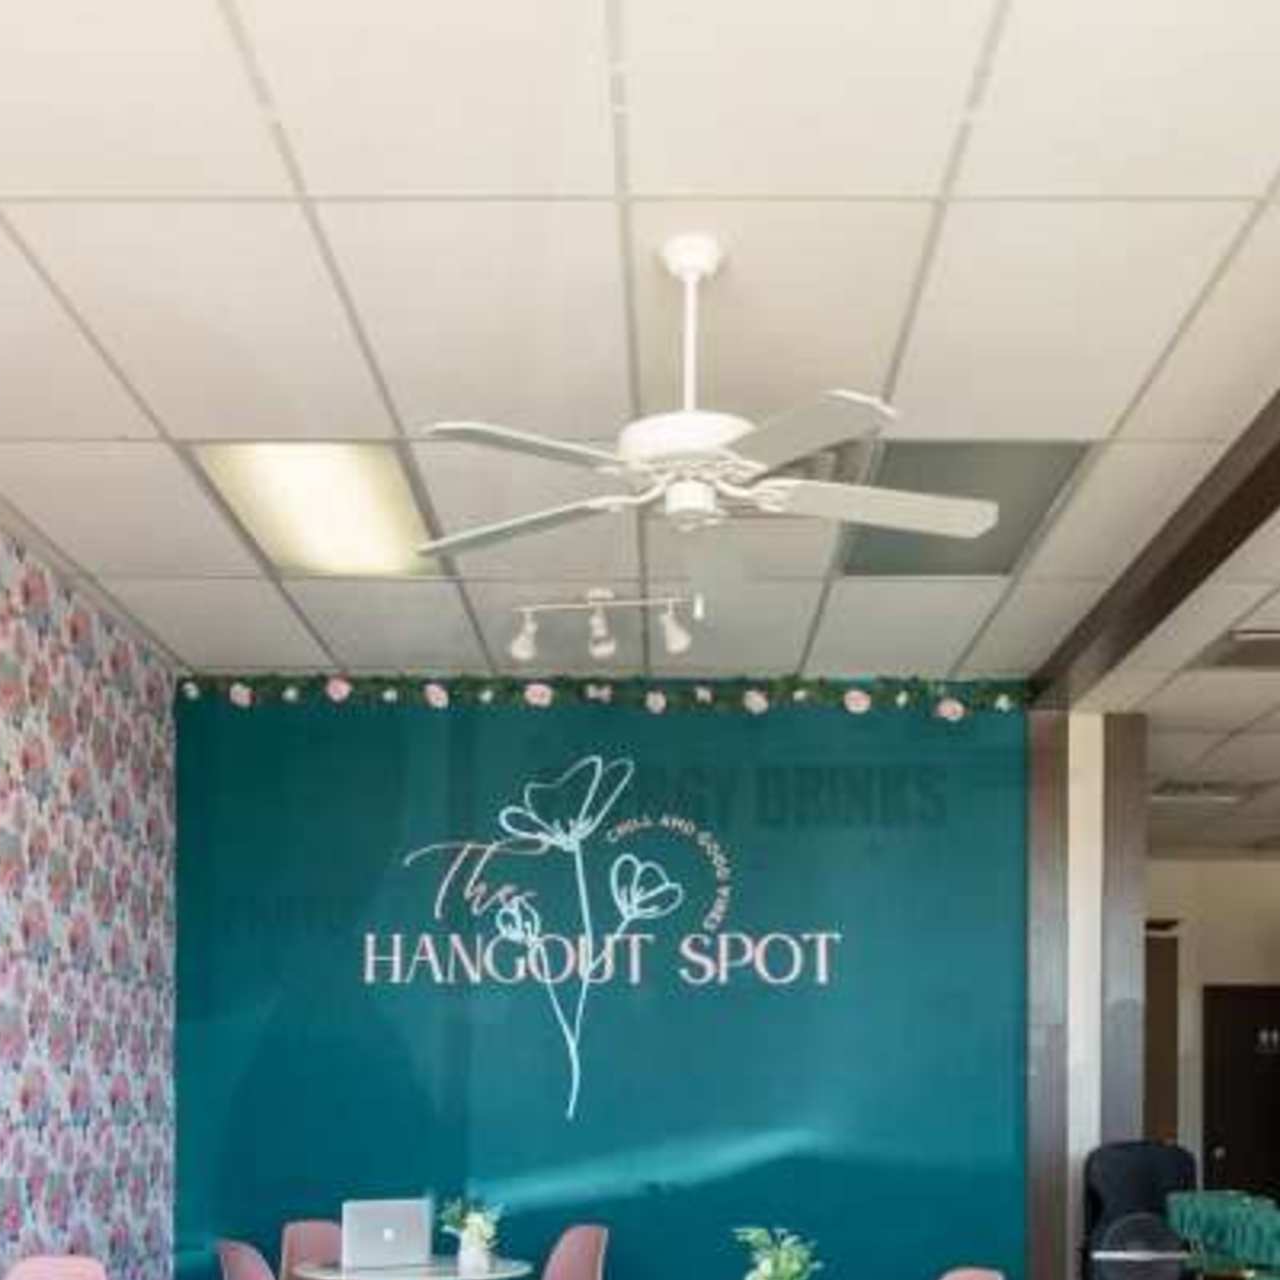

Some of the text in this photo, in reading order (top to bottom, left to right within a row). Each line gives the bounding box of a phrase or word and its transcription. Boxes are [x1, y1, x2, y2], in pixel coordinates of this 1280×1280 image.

[606, 815, 652, 843] CHILL
[660, 815, 696, 835] AND
[403, 836, 549, 919] The
[364, 932, 842, 984] HANGOUT SPOT
